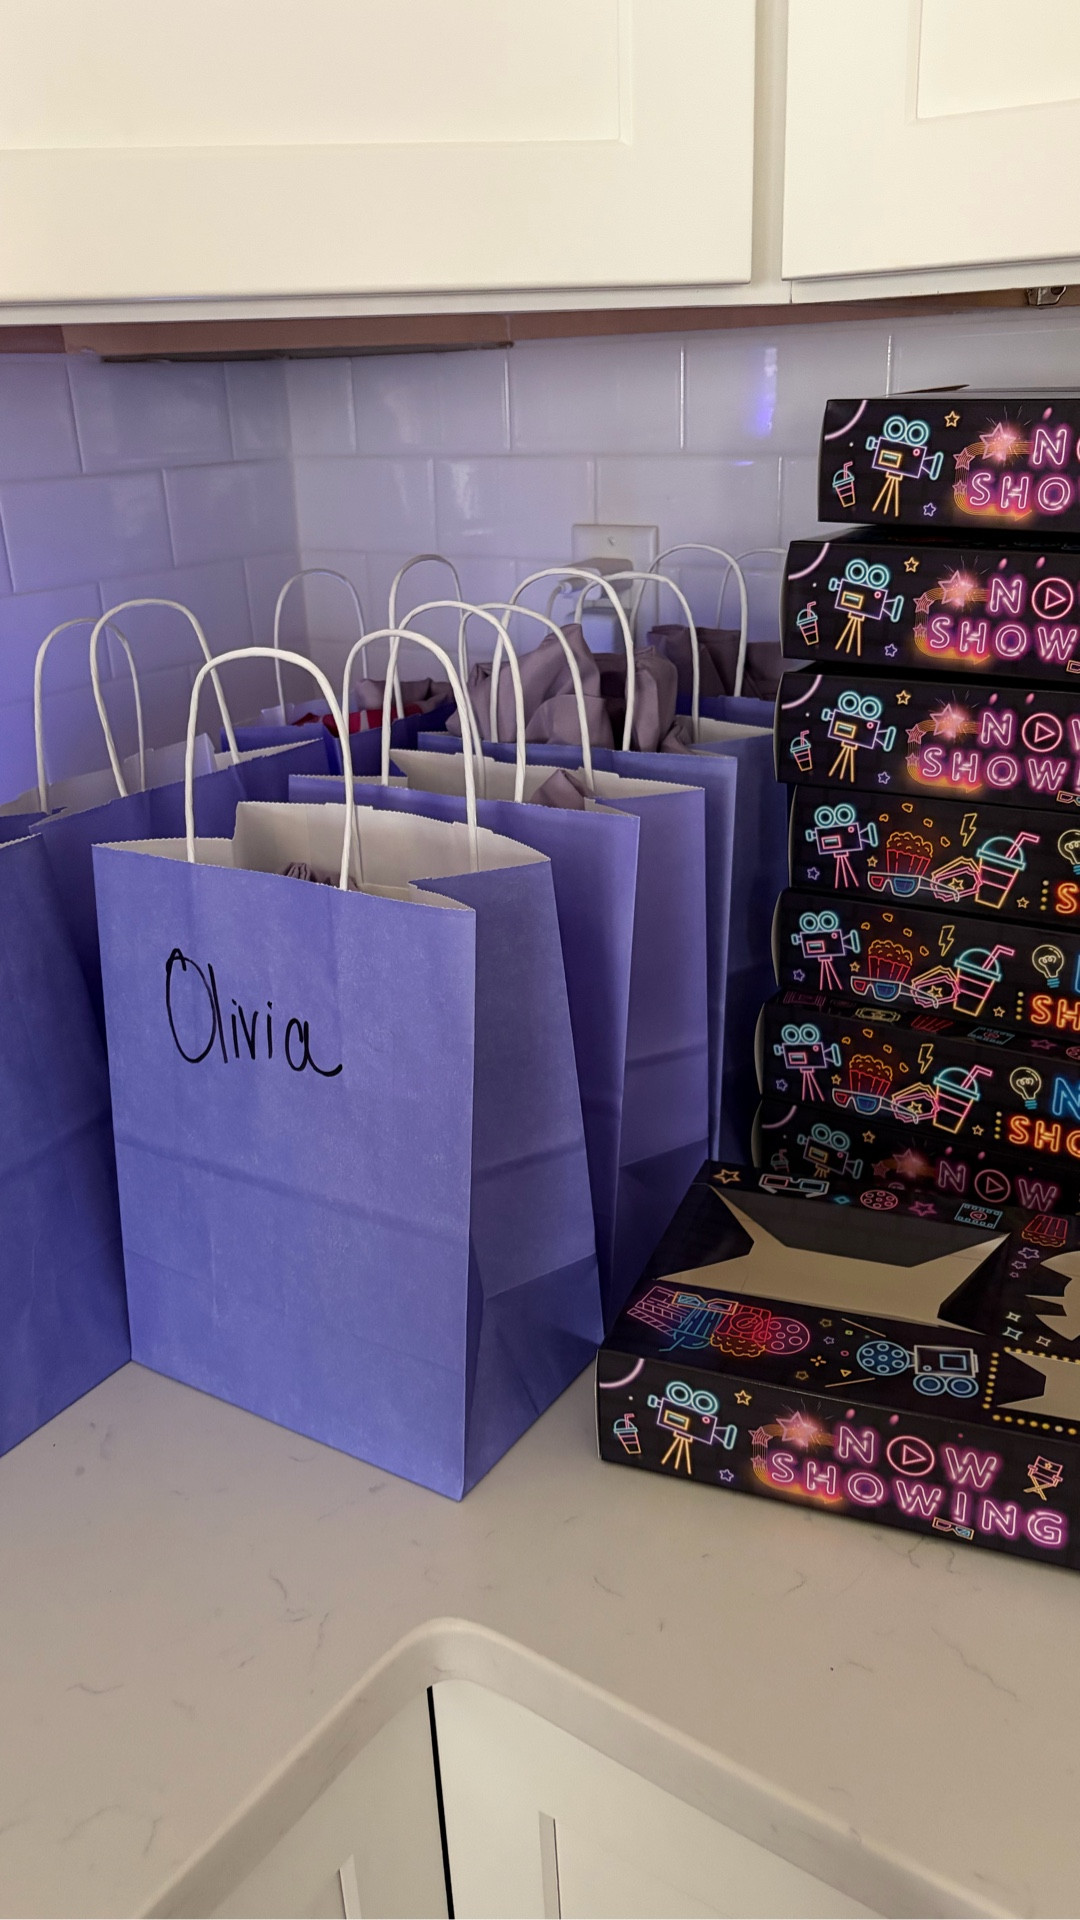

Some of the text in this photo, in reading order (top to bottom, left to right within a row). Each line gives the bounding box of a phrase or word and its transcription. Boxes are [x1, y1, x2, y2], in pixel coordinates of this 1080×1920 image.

[969, 472, 1071, 511] SHO
[929, 616, 1077, 660] SHOW
[981, 711, 1080, 753] NO
[165, 947, 343, 1077] Olivia
[938, 1160, 1058, 1212] NOW
[838, 1425, 997, 1488] NOW
[771, 1452, 1063, 1546] SHOWING
